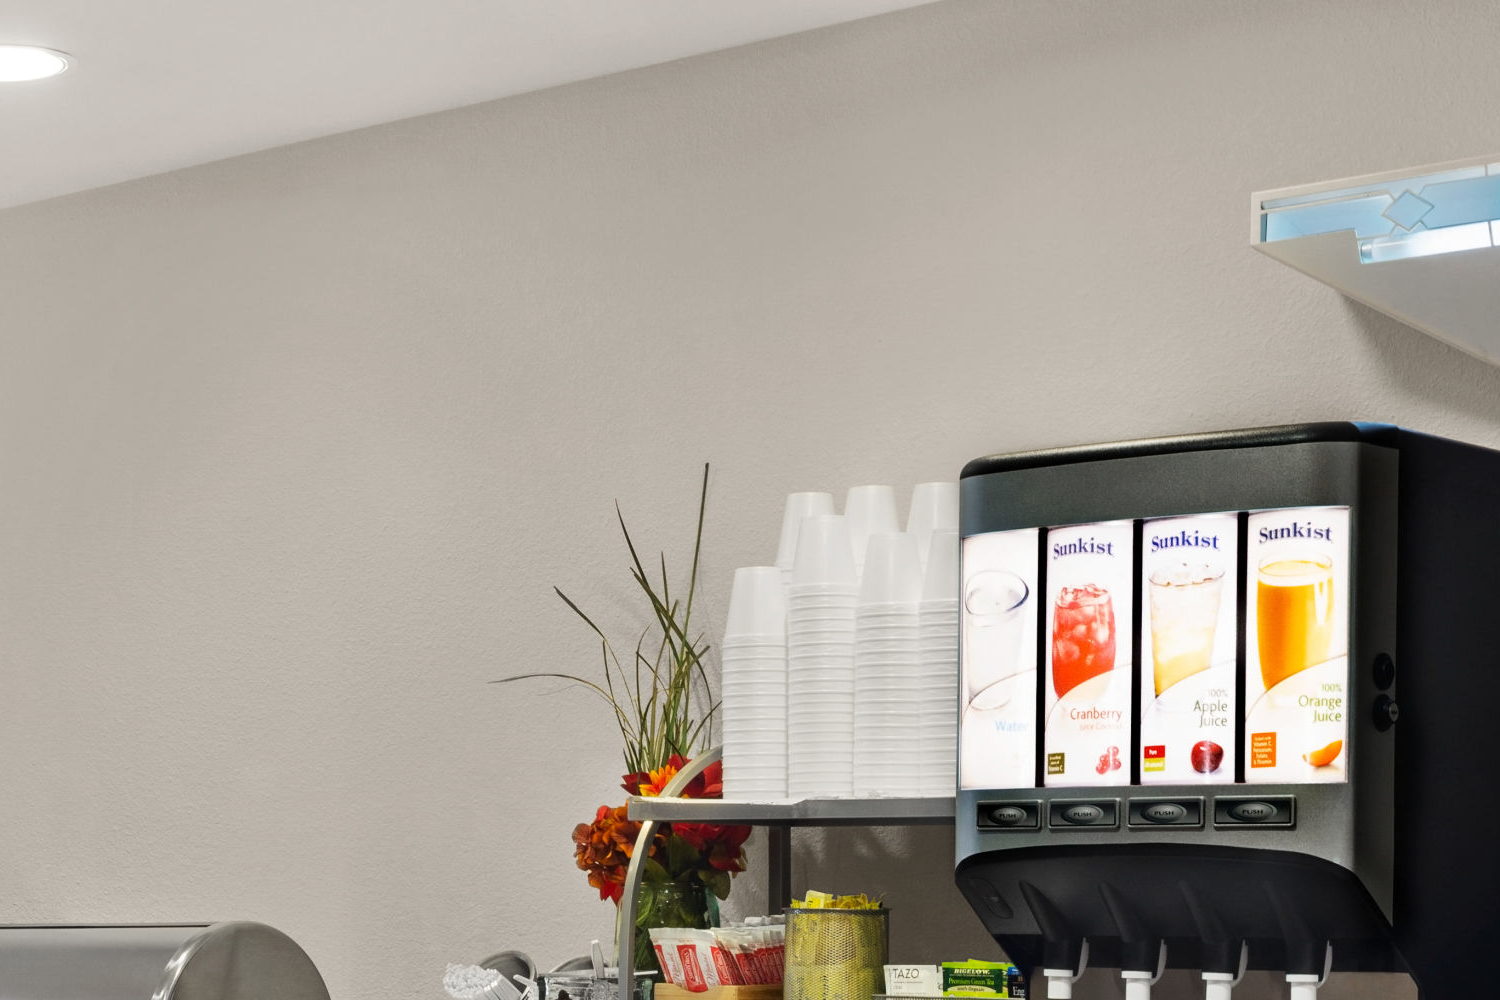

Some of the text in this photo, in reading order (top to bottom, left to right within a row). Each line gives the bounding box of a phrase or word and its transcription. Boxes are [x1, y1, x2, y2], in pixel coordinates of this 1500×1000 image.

[1259, 522, 1333, 543] Sunkist
[1053, 537, 1115, 559] Sunkist
[1151, 530, 1220, 552] Sunkist
[1322, 683, 1342, 692] 100%
[1194, 700, 1228, 714] Apple
[1298, 695, 1342, 710] Orange
[1070, 707, 1123, 721] Cranberry
[1199, 714, 1228, 728] Juice
[1313, 710, 1342, 723] Juice
[995, 720, 1029, 732] Water
[892, 968, 919, 978] TAZO
